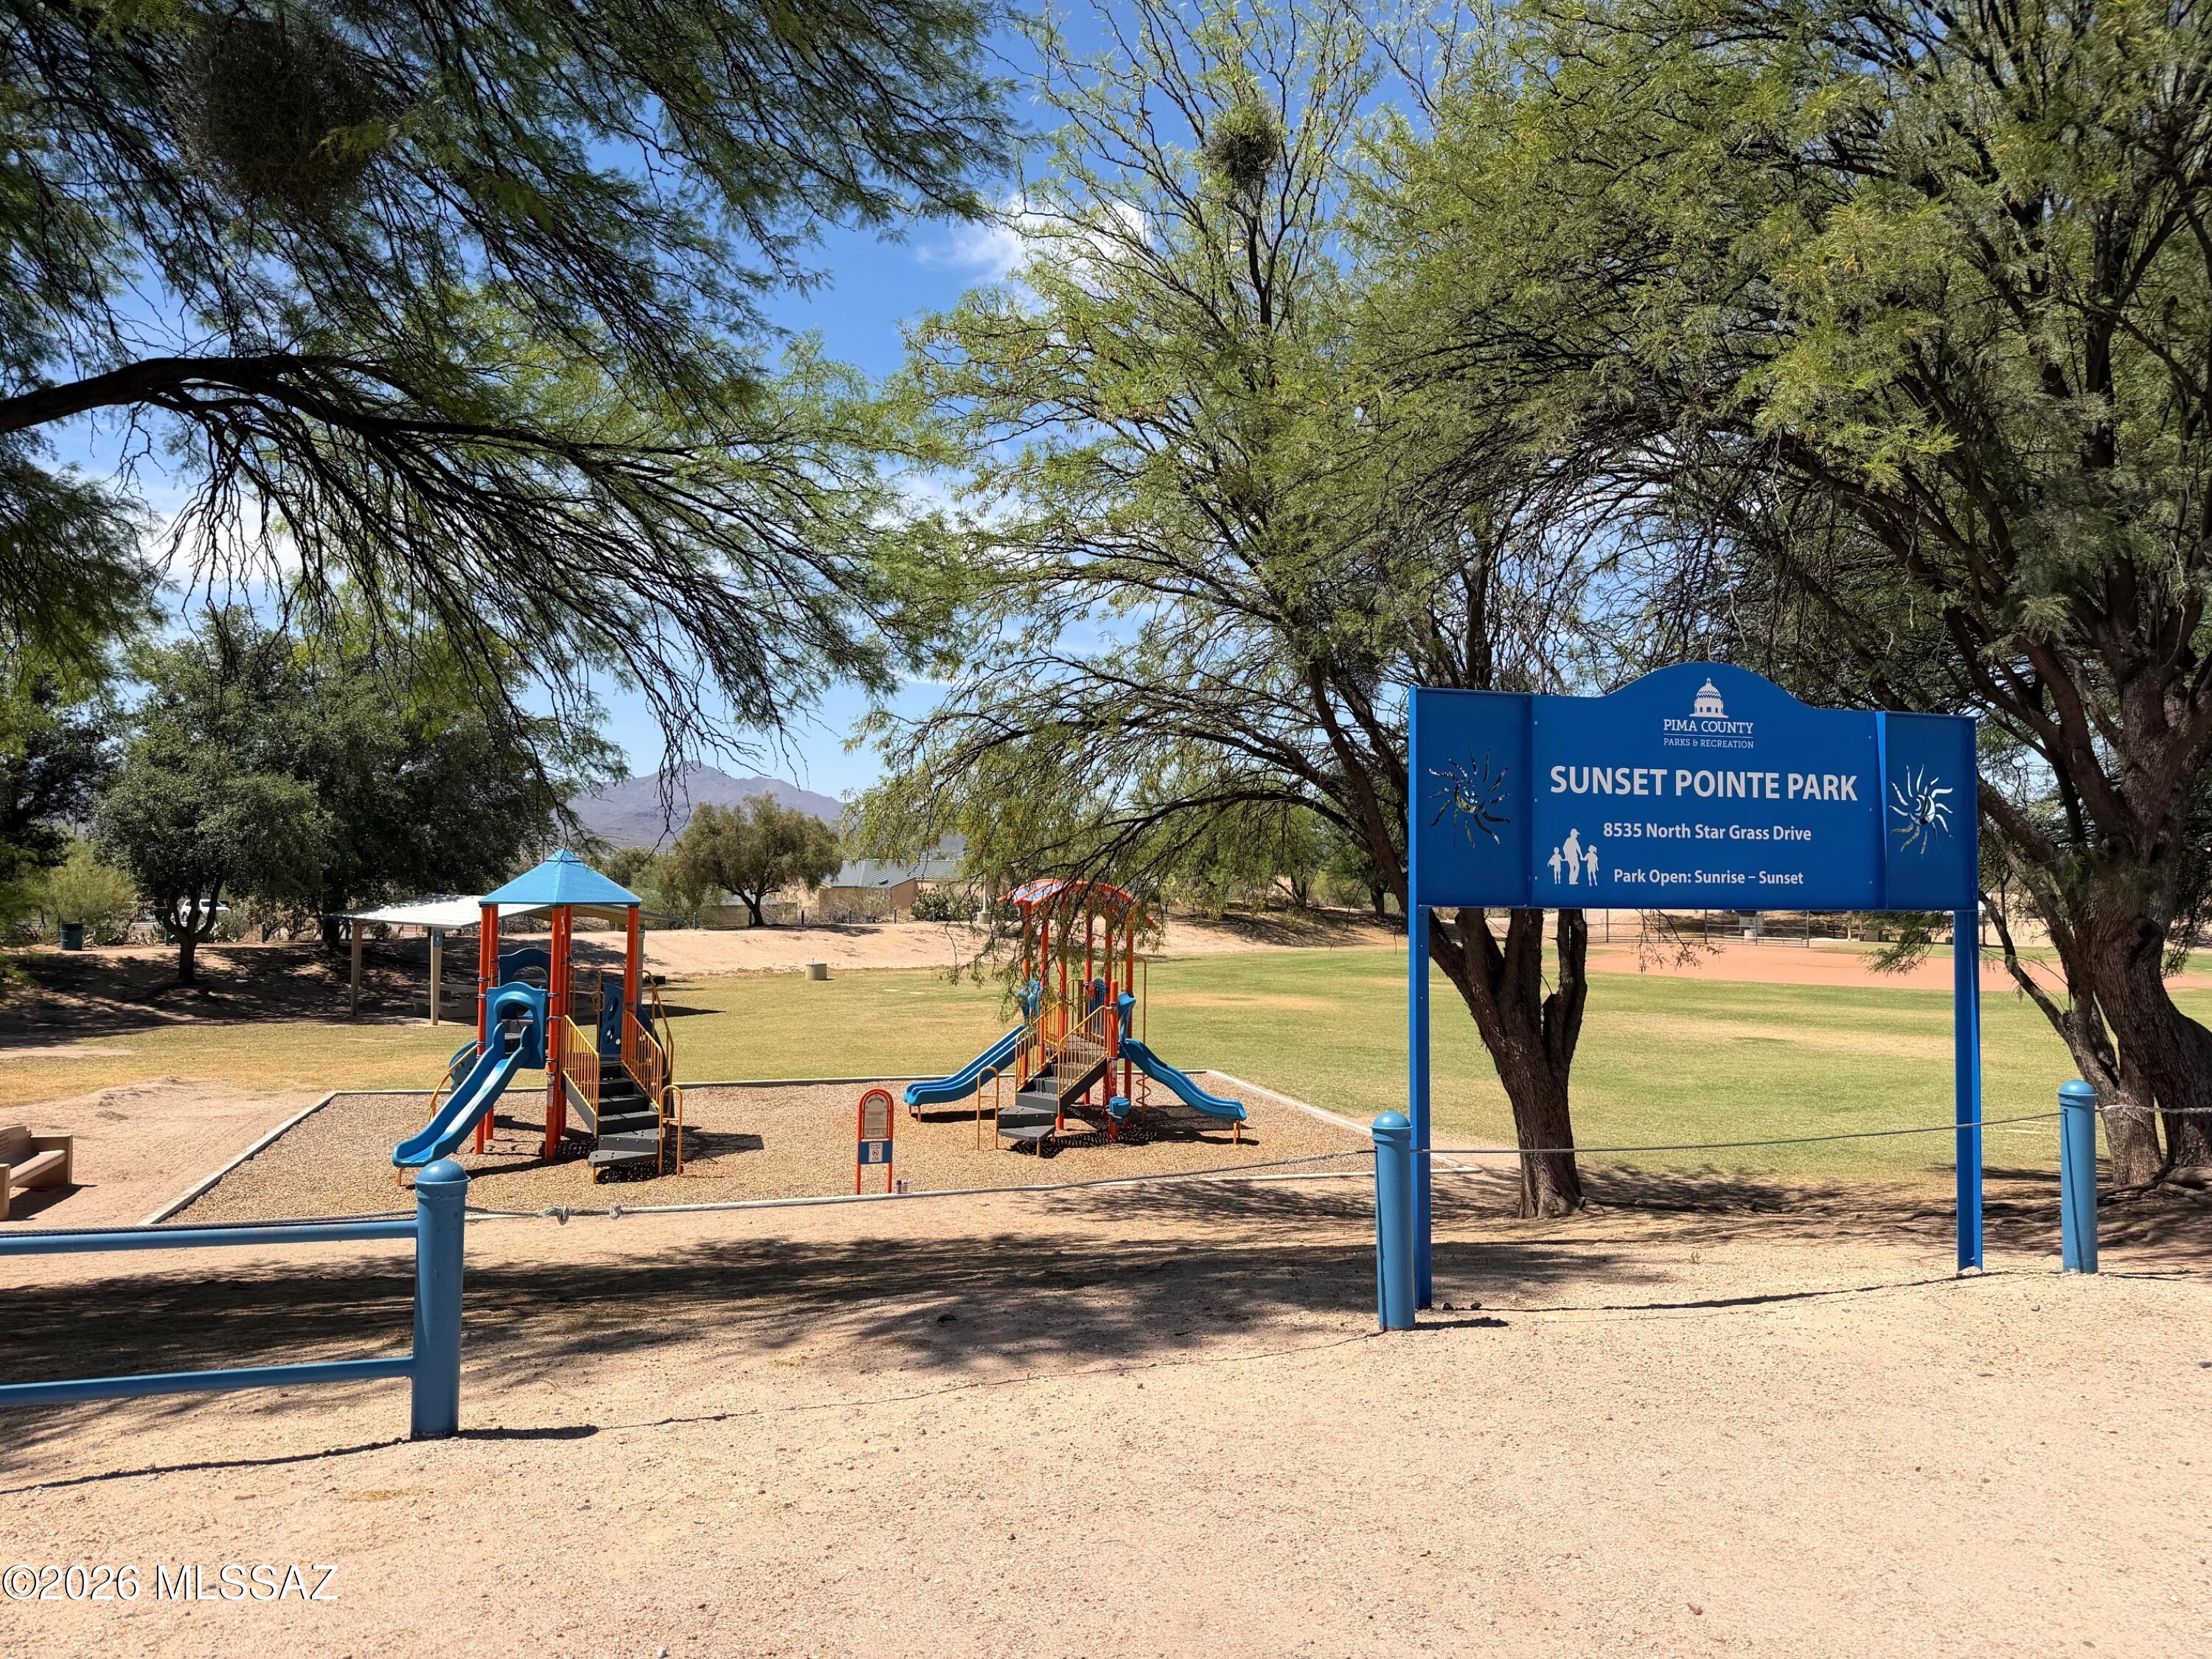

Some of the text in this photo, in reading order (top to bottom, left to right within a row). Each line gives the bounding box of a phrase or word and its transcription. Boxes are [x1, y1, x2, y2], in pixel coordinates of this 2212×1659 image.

[1663, 719, 1754, 734] PIMA COUNTY
[1663, 737, 1753, 748] PARKS & RECREATION
[1550, 765, 1858, 801] SUNSET POINTE PARK
[1603, 822, 1812, 841] 8535 North Star Grass Drive
[1614, 869, 1646, 883] Park
[1649, 869, 1691, 886] Open:
[1694, 870, 1745, 884] Sunrise
[1759, 871, 1804, 884] Sunset
